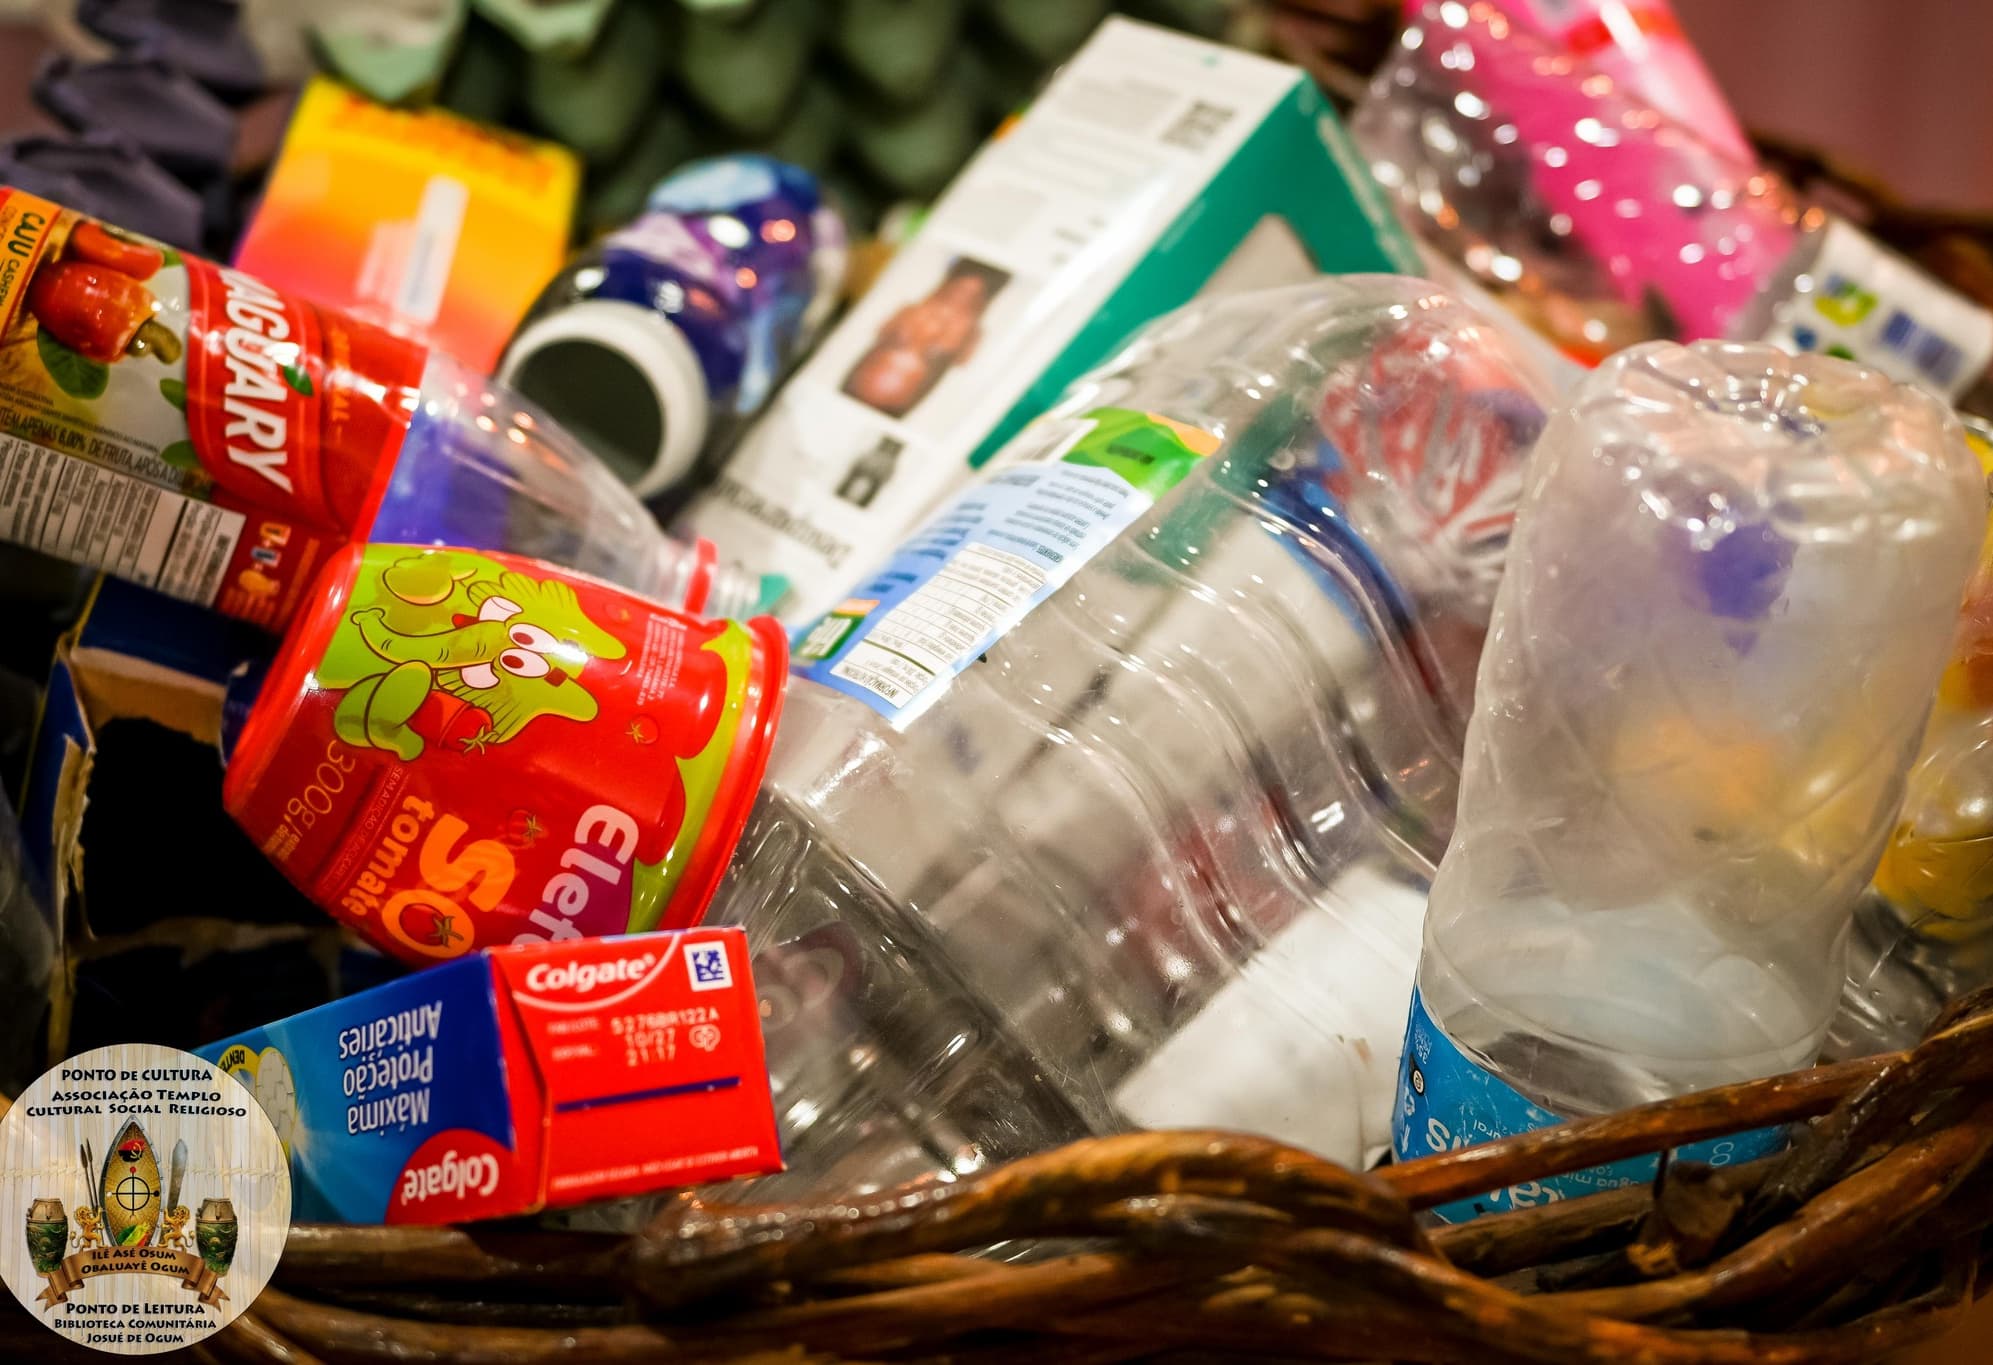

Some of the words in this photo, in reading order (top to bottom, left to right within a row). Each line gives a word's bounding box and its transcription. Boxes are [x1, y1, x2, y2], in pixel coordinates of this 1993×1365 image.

[8, 211, 46, 258] CAJU
[287, 739, 356, 830] 300g
[341, 794, 436, 917] tomate
[512, 803, 640, 947] Elef
[526, 956, 648, 993] Colgate
[339, 1000, 443, 1062] Anticáries
[343, 1045, 433, 1100] Proteção
[347, 1087, 430, 1137] Máxima
[402, 1150, 500, 1203] Colgate
